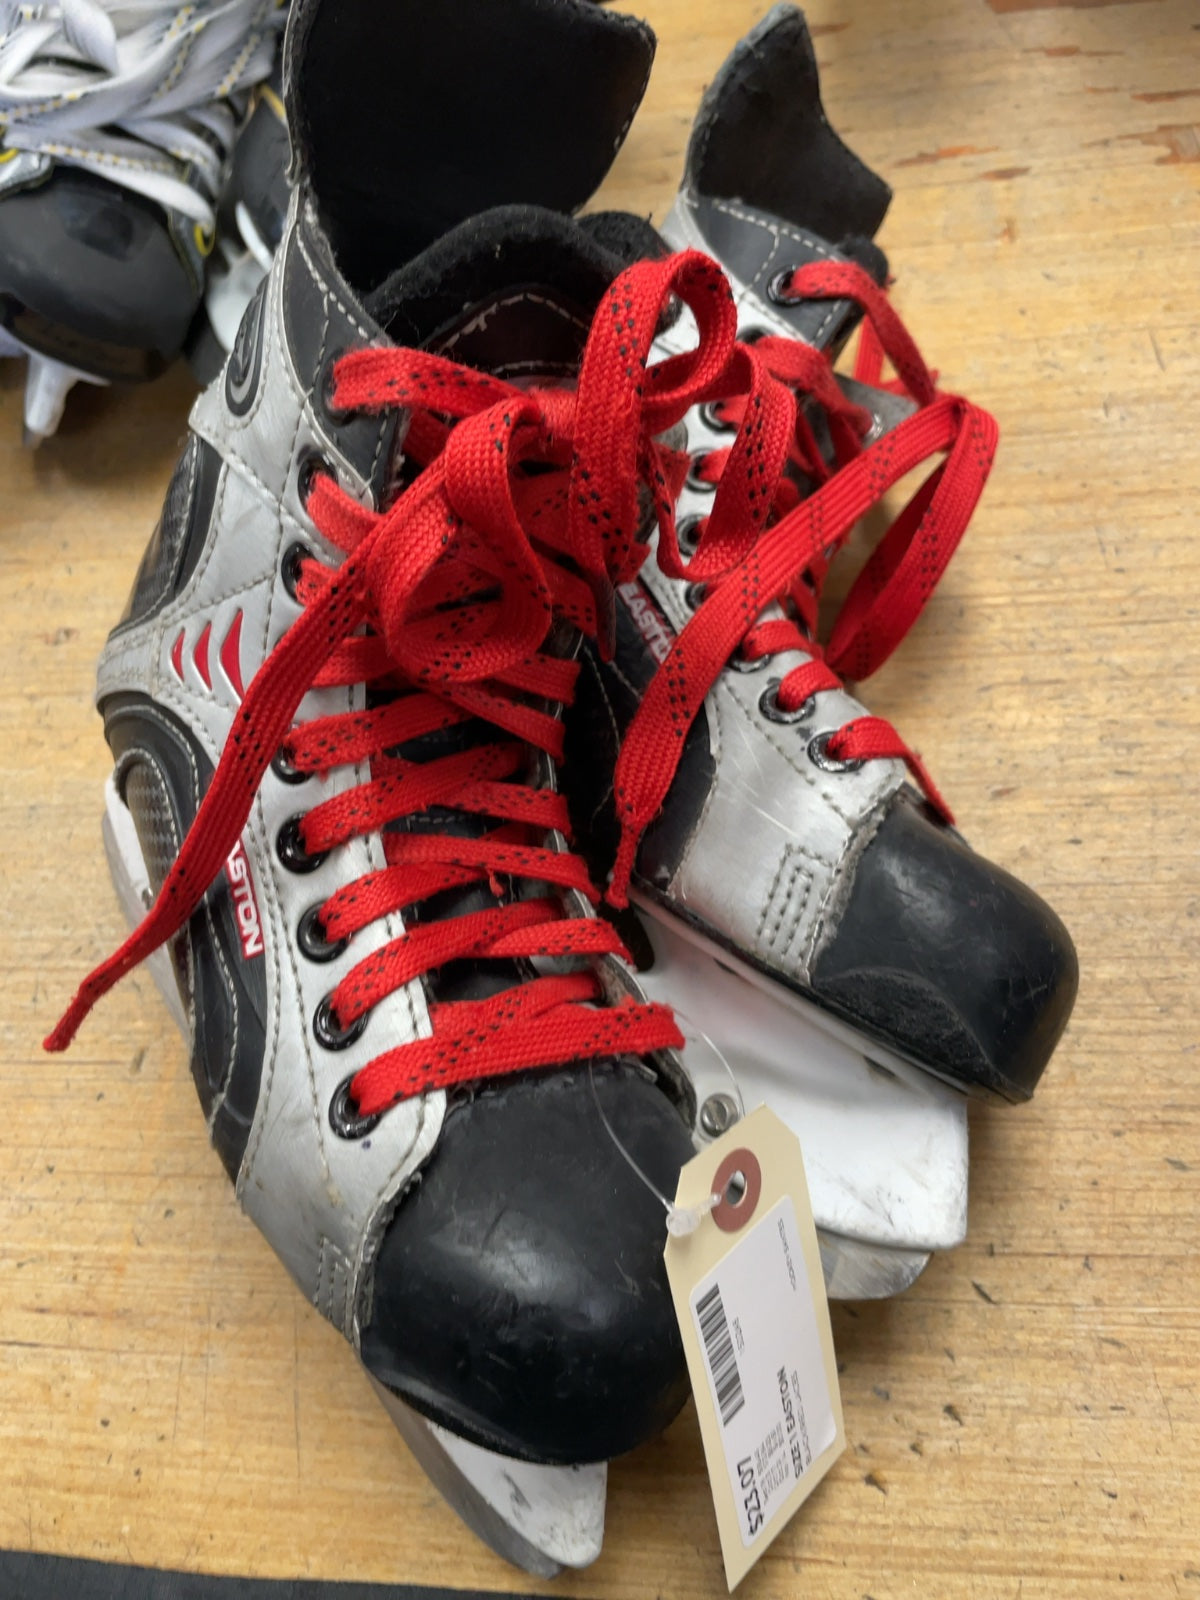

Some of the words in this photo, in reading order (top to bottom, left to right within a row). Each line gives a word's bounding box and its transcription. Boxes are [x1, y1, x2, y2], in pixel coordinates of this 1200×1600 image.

[618, 582, 672, 664] EASTO
[777, 1365, 794, 1433] EASTON
[736, 1456, 763, 1535] $23.07
[790, 1441, 802, 1478] SIZE
